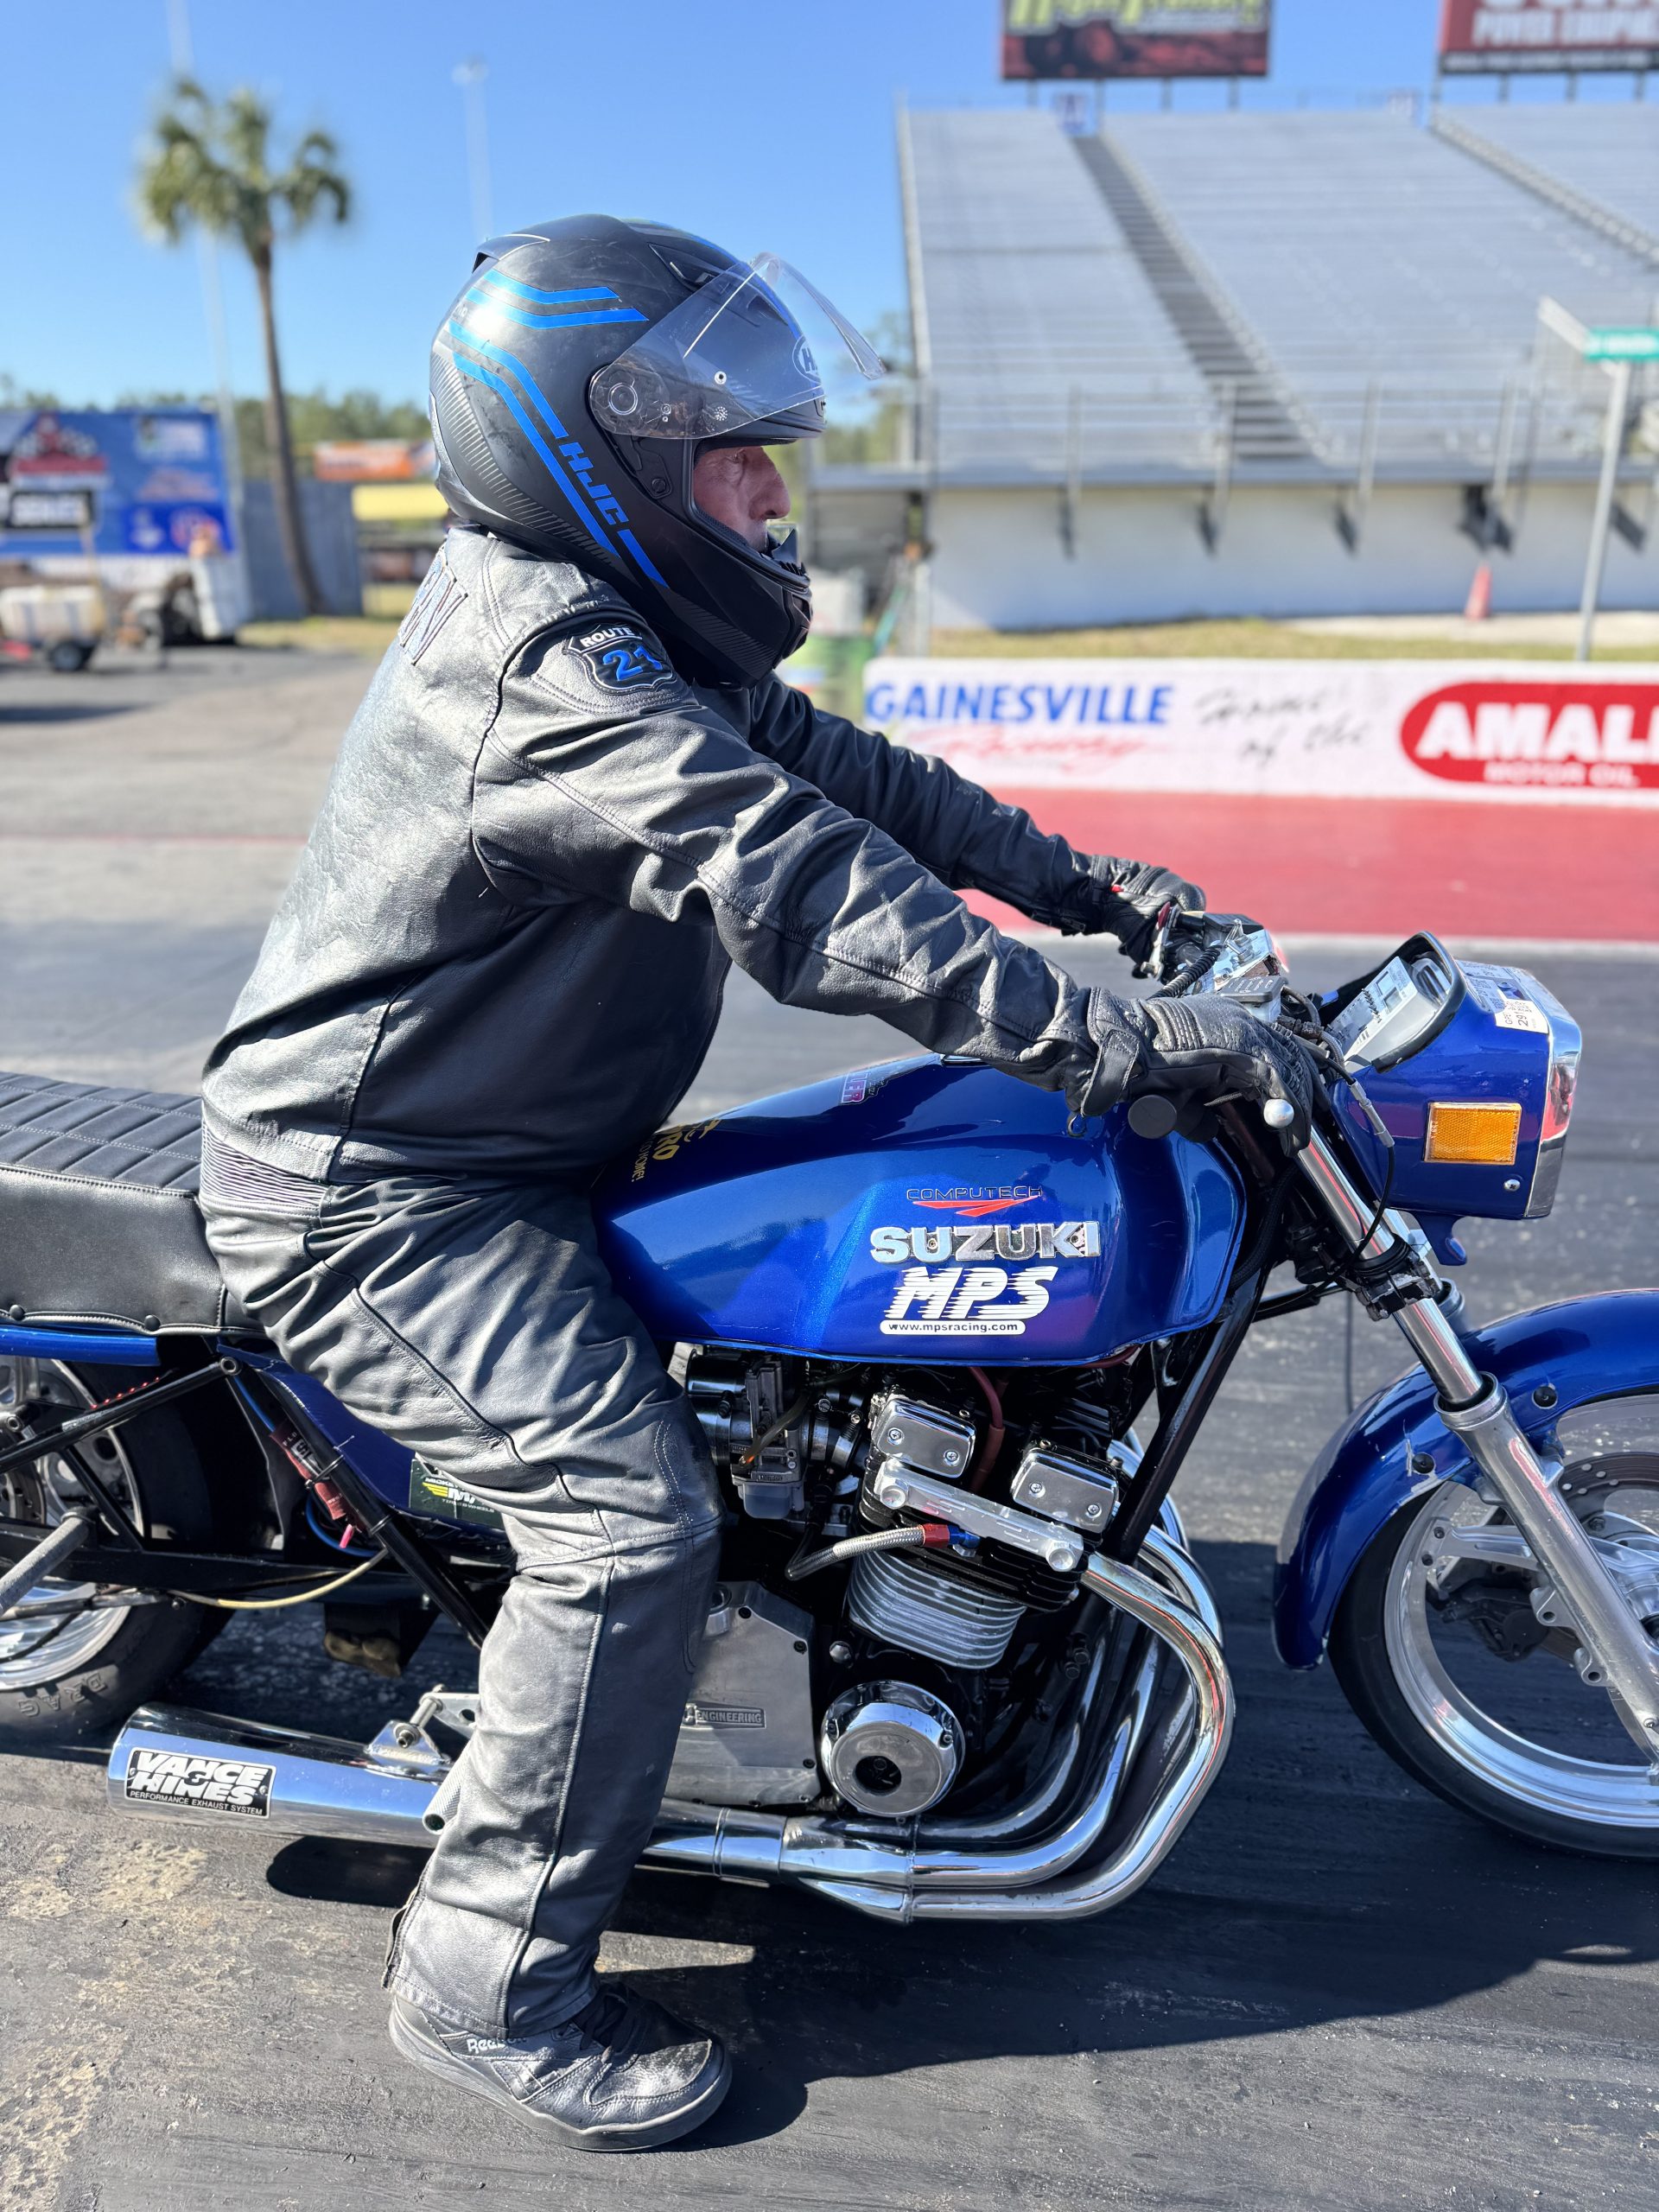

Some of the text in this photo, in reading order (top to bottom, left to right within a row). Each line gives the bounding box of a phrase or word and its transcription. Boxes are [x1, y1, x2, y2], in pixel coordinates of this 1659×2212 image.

[558, 442, 629, 525] HJC
[579, 626, 636, 647] ROUTE
[602, 645, 664, 682] 21
[865, 683, 1176, 724] GAINESVILLE
[906, 1185, 1042, 1201] COMPUTECH
[870, 1220, 1102, 1264] SUZUKI
[882, 1266, 1059, 1320] MPS
[888, 1322, 1019, 1334] www.mpsracing.com
[17, 1671, 108, 1718] DRAG
[696, 1710, 763, 1724] ENGINEERING
[130, 1770, 256, 1806] HINES
[136, 1751, 269, 1788] VANCE
[130, 1790, 264, 1815] PERFORMANCE EXHAUST SYSTEM
